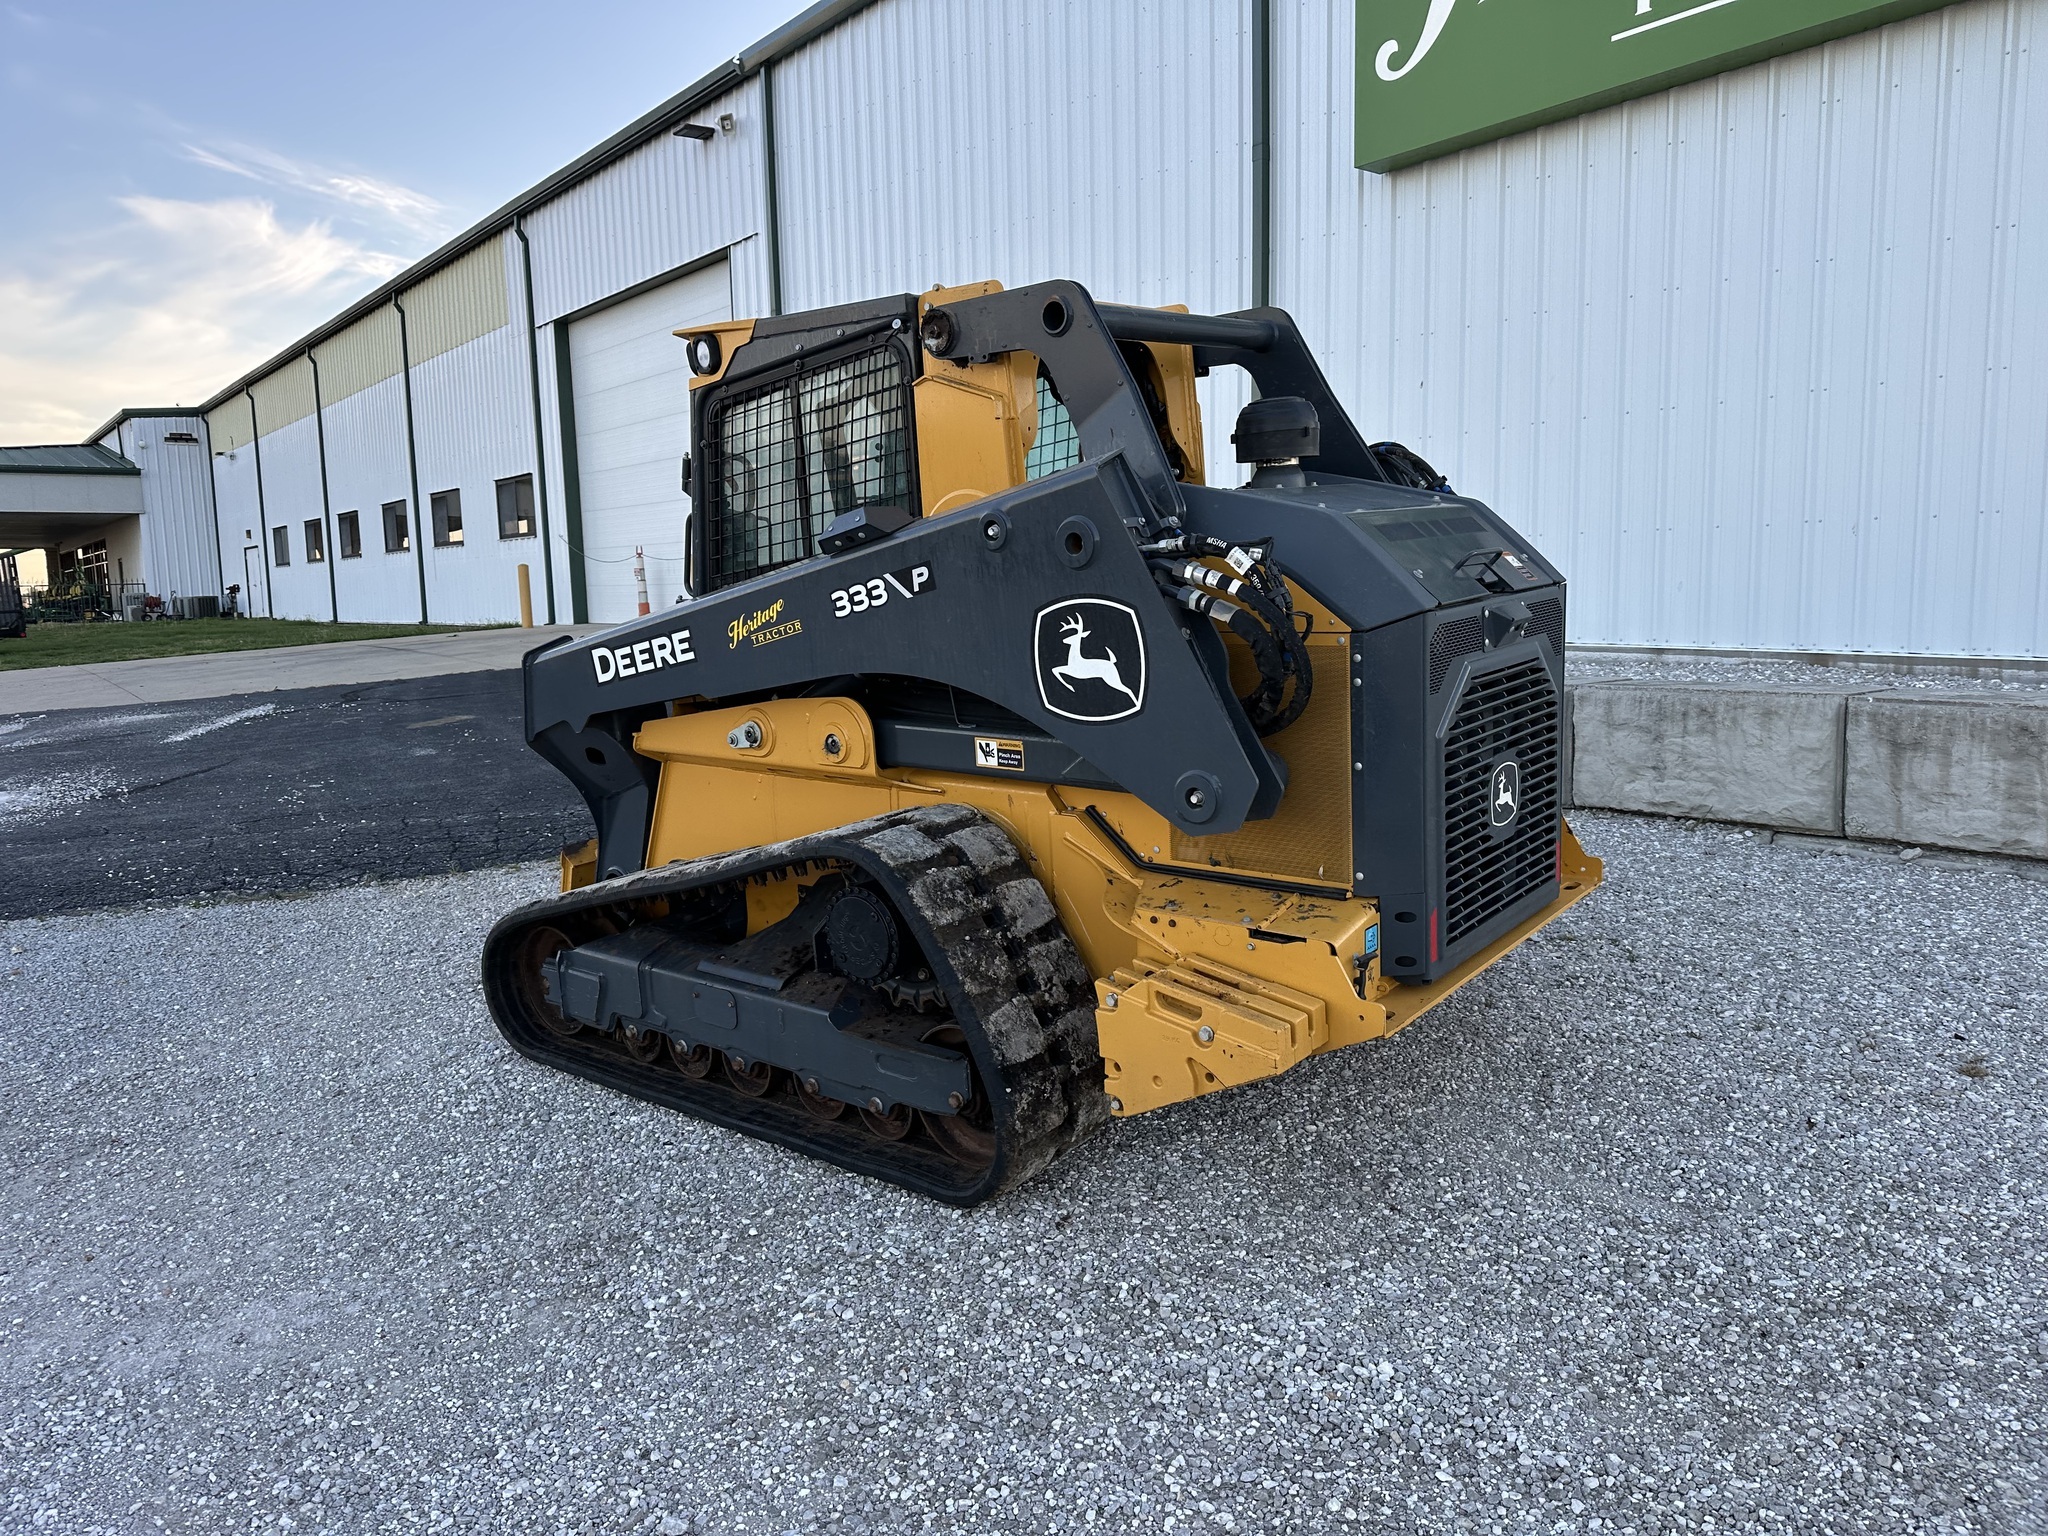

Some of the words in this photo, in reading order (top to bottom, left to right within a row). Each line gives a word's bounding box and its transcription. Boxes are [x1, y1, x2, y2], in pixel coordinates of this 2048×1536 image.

[1206, 536, 1228, 549] MSHA
[727, 598, 785, 649] Heritage
[750, 622, 802, 645] TRACTOR
[591, 629, 696, 684] DEERE
